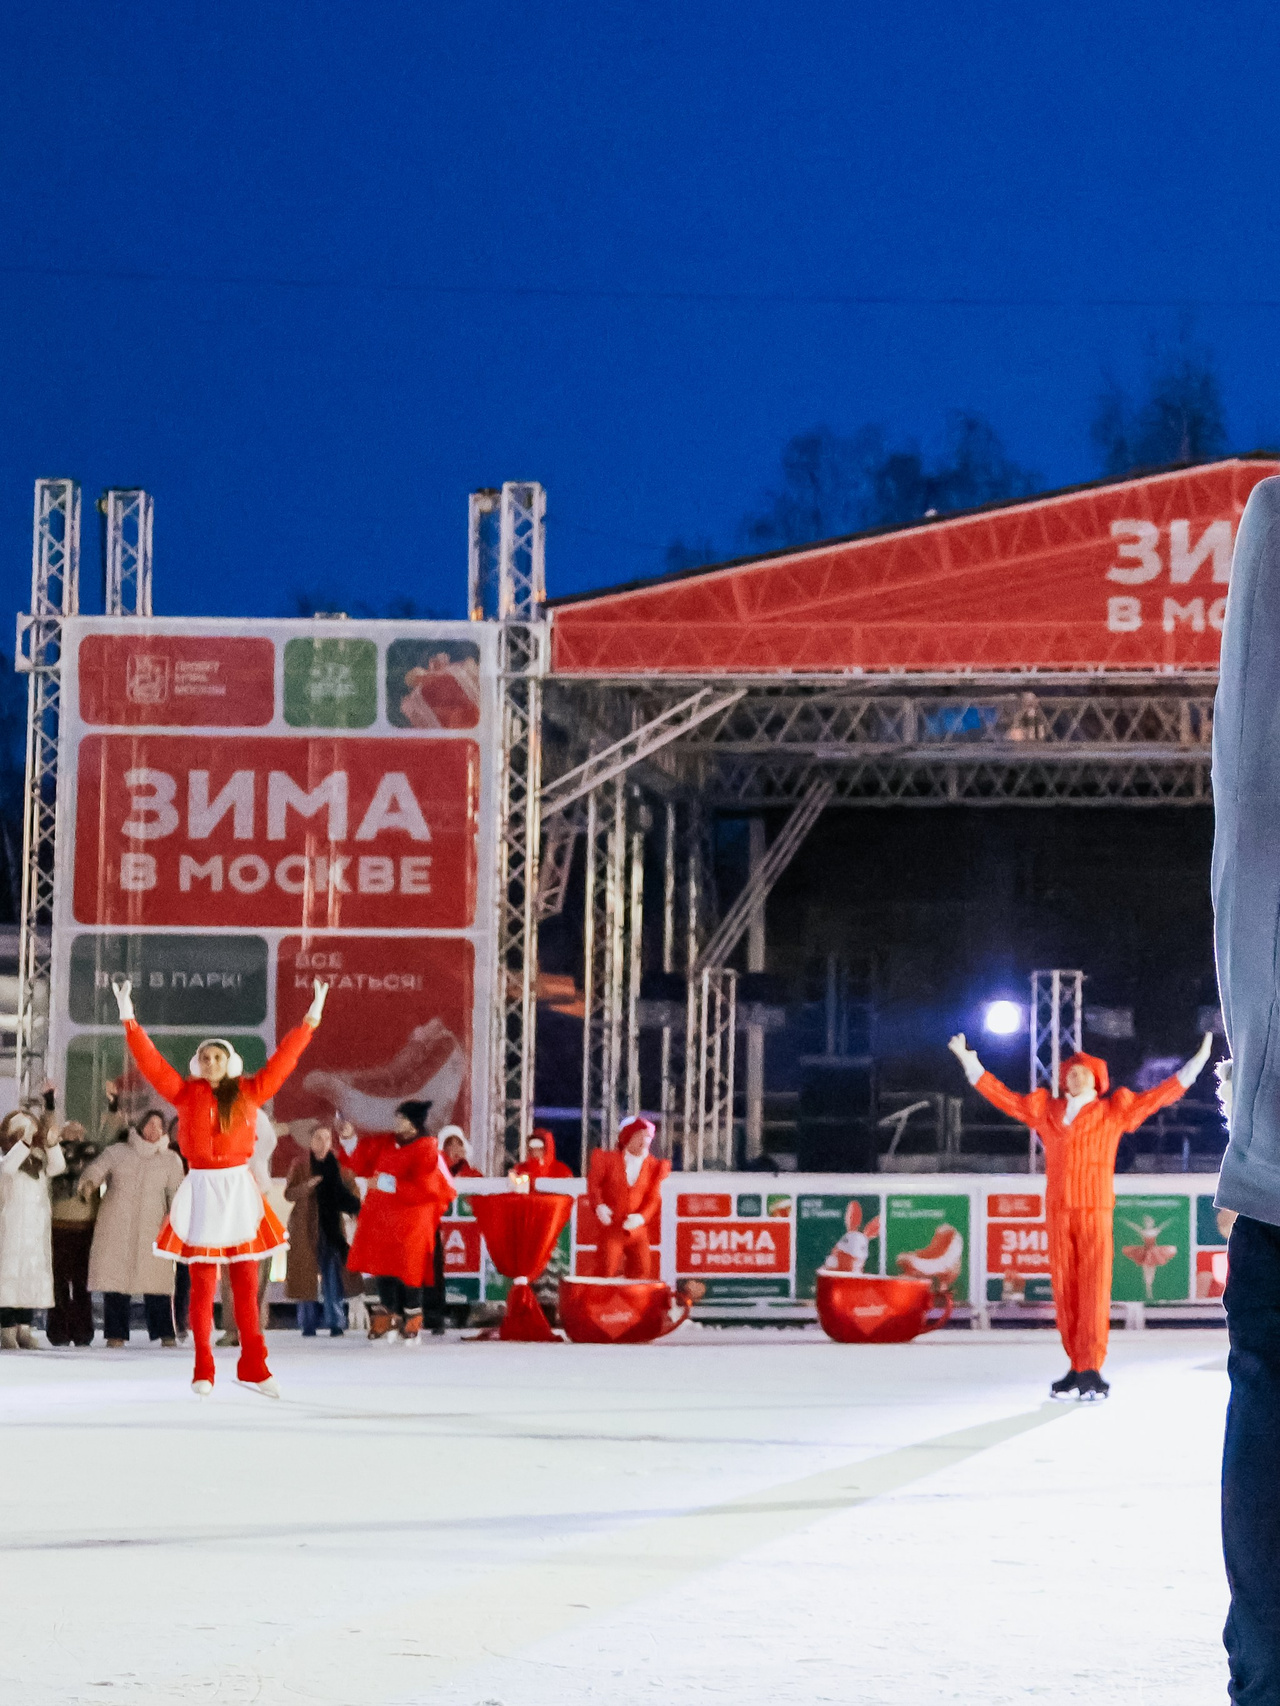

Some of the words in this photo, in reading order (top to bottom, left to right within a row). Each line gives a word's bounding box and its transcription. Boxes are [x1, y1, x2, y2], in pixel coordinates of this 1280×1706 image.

[1107, 596, 1142, 632] В
[121, 767, 432, 842] ЗИМА
[120, 853, 157, 891] В
[179, 854, 433, 895] МОСКВЕ
[690, 1229, 776, 1251] ЗИМА
